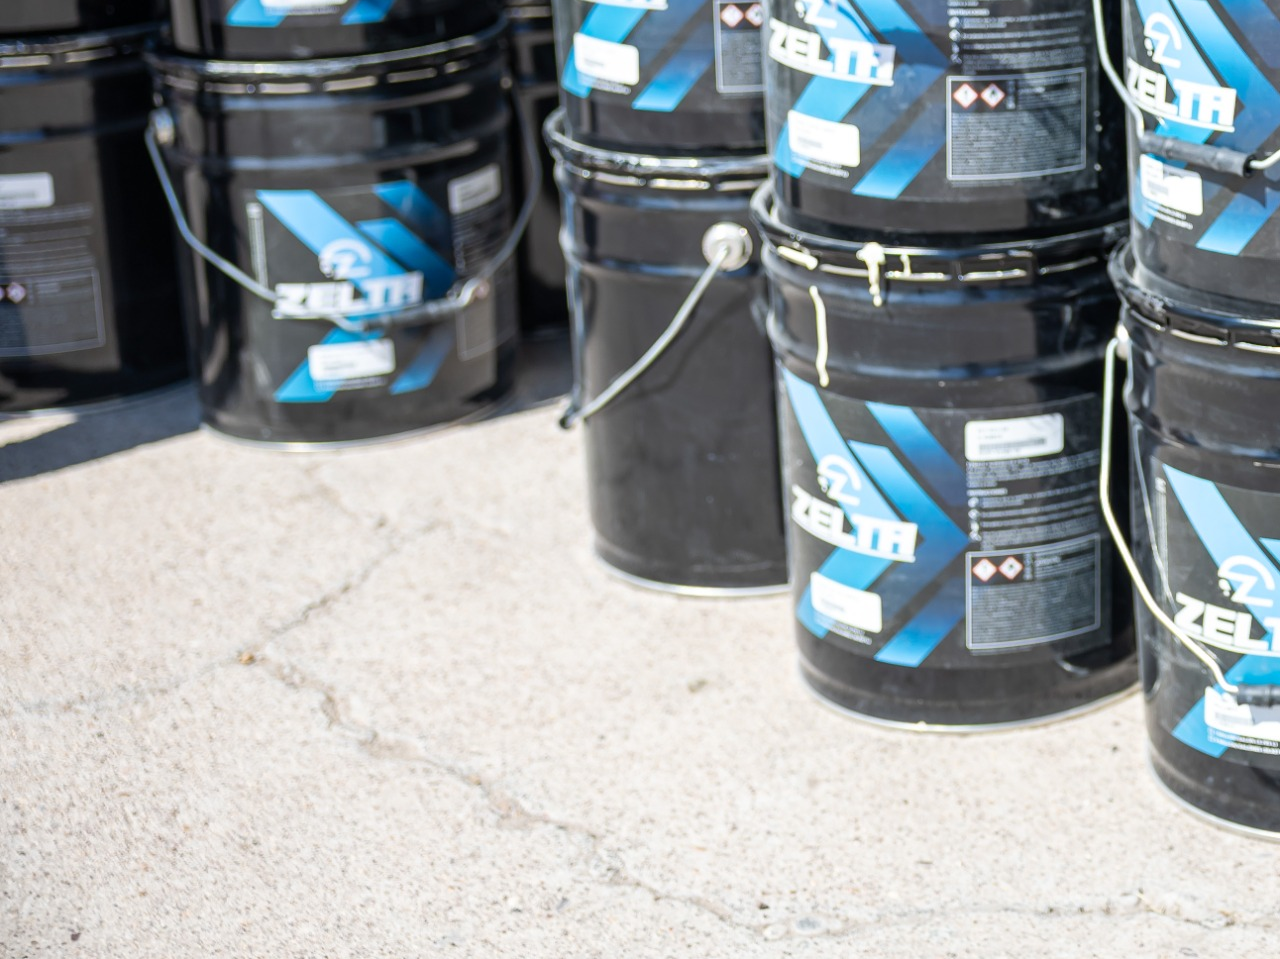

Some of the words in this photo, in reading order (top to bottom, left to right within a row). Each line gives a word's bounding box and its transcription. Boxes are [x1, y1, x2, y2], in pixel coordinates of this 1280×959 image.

[769, 17, 896, 80] ZELTA
[1125, 56, 1237, 126] ZELTA
[274, 271, 424, 310] ZELTA
[792, 484, 918, 555] ZELTA
